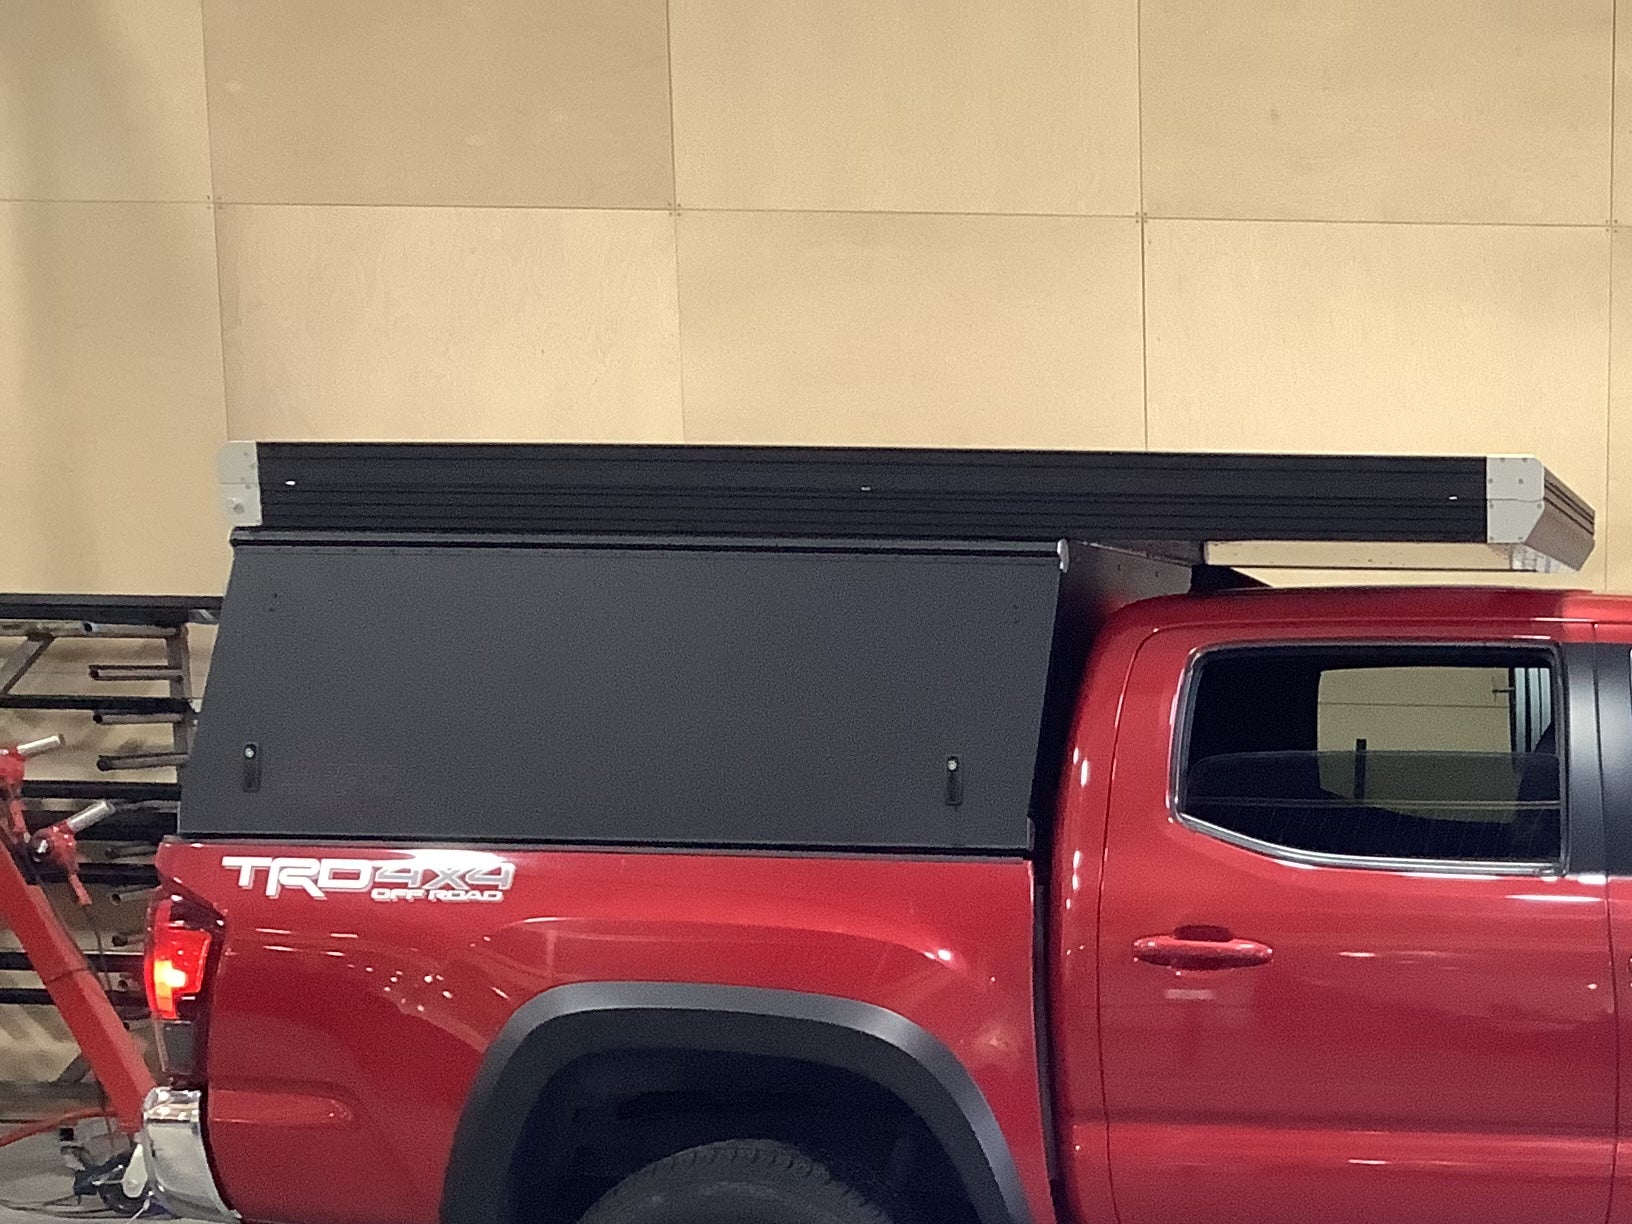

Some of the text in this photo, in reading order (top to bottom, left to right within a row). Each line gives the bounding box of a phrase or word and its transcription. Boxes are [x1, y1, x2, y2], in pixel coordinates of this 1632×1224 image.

[221, 856, 374, 900] TRD
[370, 888, 504, 902] OFF ROAD
